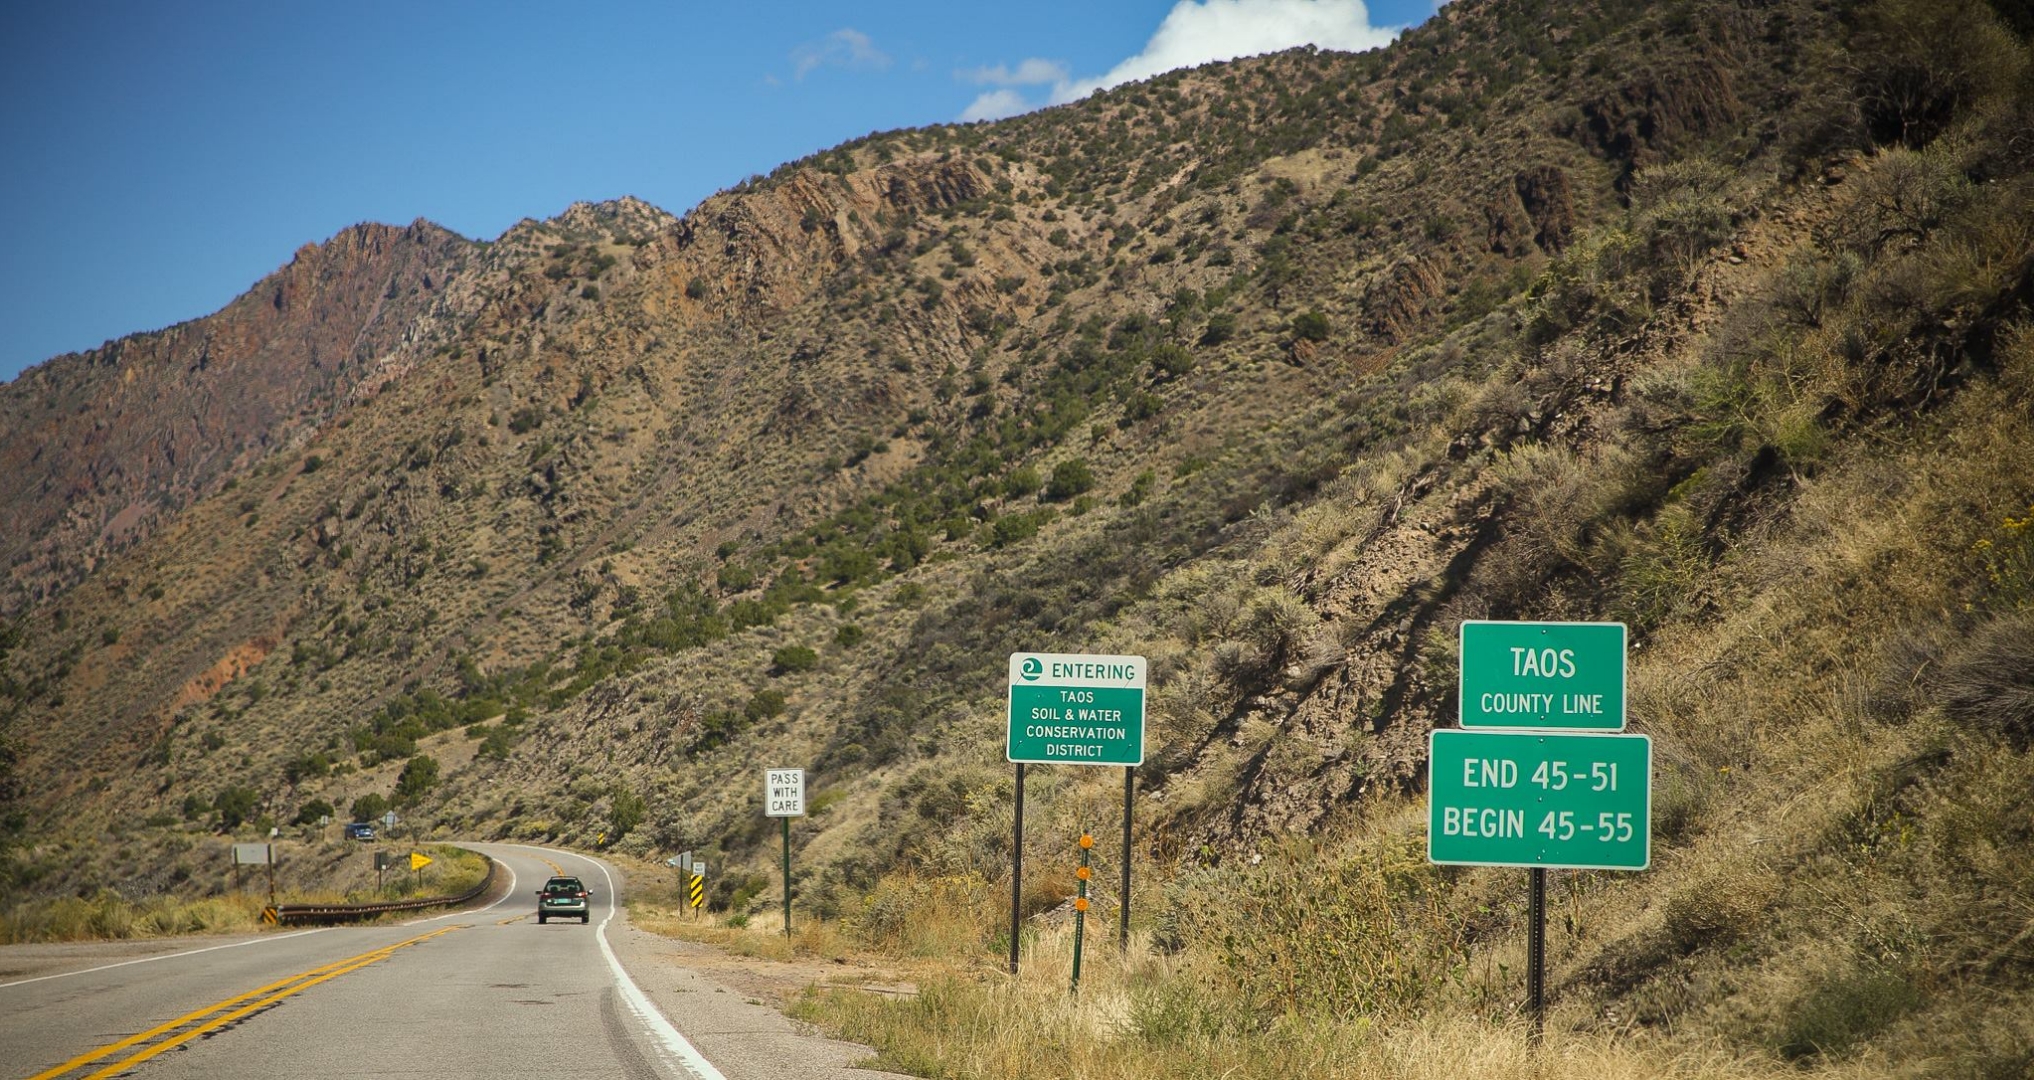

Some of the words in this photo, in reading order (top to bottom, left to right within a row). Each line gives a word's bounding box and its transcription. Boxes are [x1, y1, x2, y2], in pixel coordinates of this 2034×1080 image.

[1510, 647, 1576, 678] TAOS
[1052, 663, 1135, 680] ENTERING
[1060, 690, 1094, 703] TAOS
[1481, 693, 1554, 713] COUNTY
[1563, 694, 1603, 714] LINE
[1031, 707, 1060, 720] SOIL
[1064, 708, 1075, 721] &
[1078, 708, 1121, 722] WATER
[1026, 725, 1126, 740] CONSERVATION
[1046, 743, 1103, 757] DISTRICT
[771, 773, 799, 785] PASS
[1463, 758, 1518, 788] END
[1531, 761, 1617, 791] 45-51
[773, 787, 798, 798] WITH
[772, 800, 799, 811] CARE
[1443, 807, 1524, 838] BEGIN
[1538, 811, 1633, 842] 45-55
